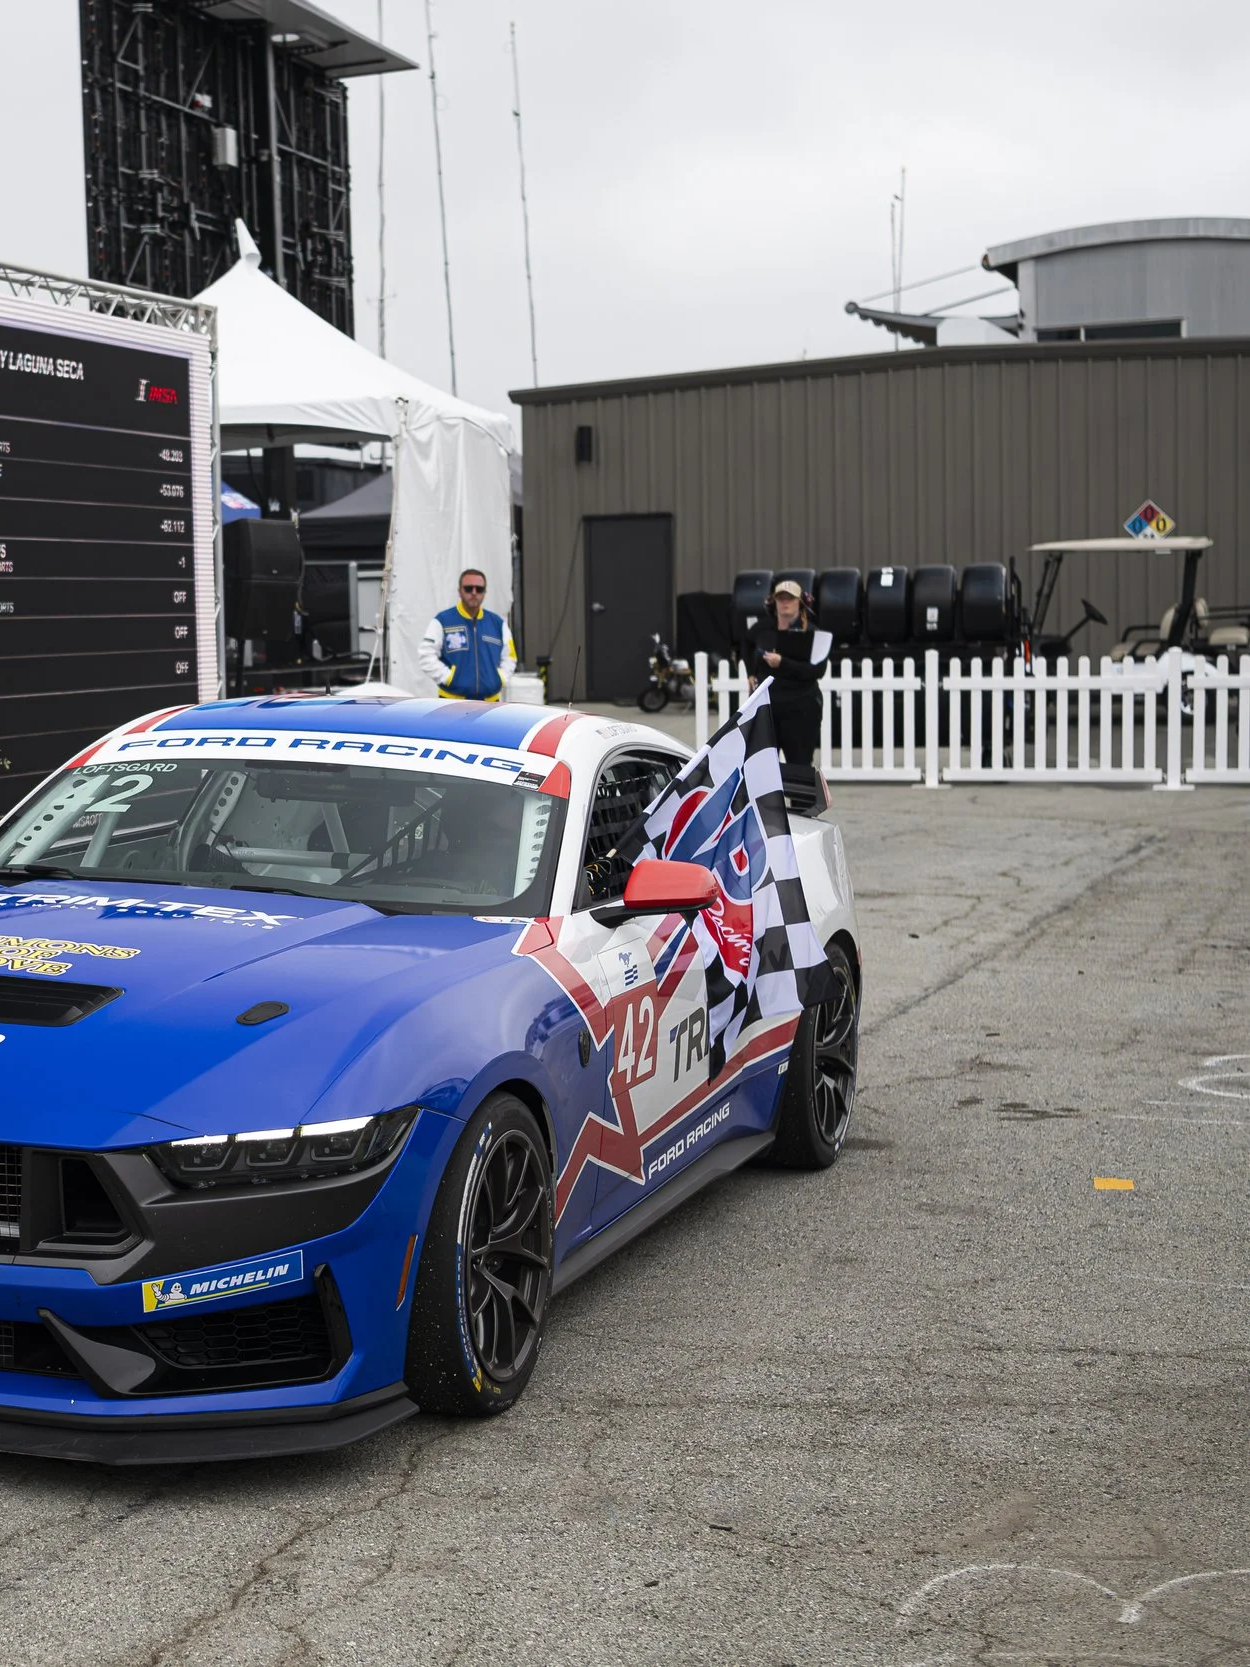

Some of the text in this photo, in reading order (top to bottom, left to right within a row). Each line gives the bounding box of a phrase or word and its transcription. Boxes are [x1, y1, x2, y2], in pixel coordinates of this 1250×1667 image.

[8, 351, 54, 375] LAGUNA
[55, 358, 84, 381] SECA
[1156, 517, 1167, 533] 0
[72, 763, 178, 775] LOFTSGARD
[117, 735, 526, 773] FORD RACING
[617, 995, 655, 1085] 42
[648, 1102, 730, 1180] FORD RACING
[190, 1264, 290, 1295] MICHELIN
